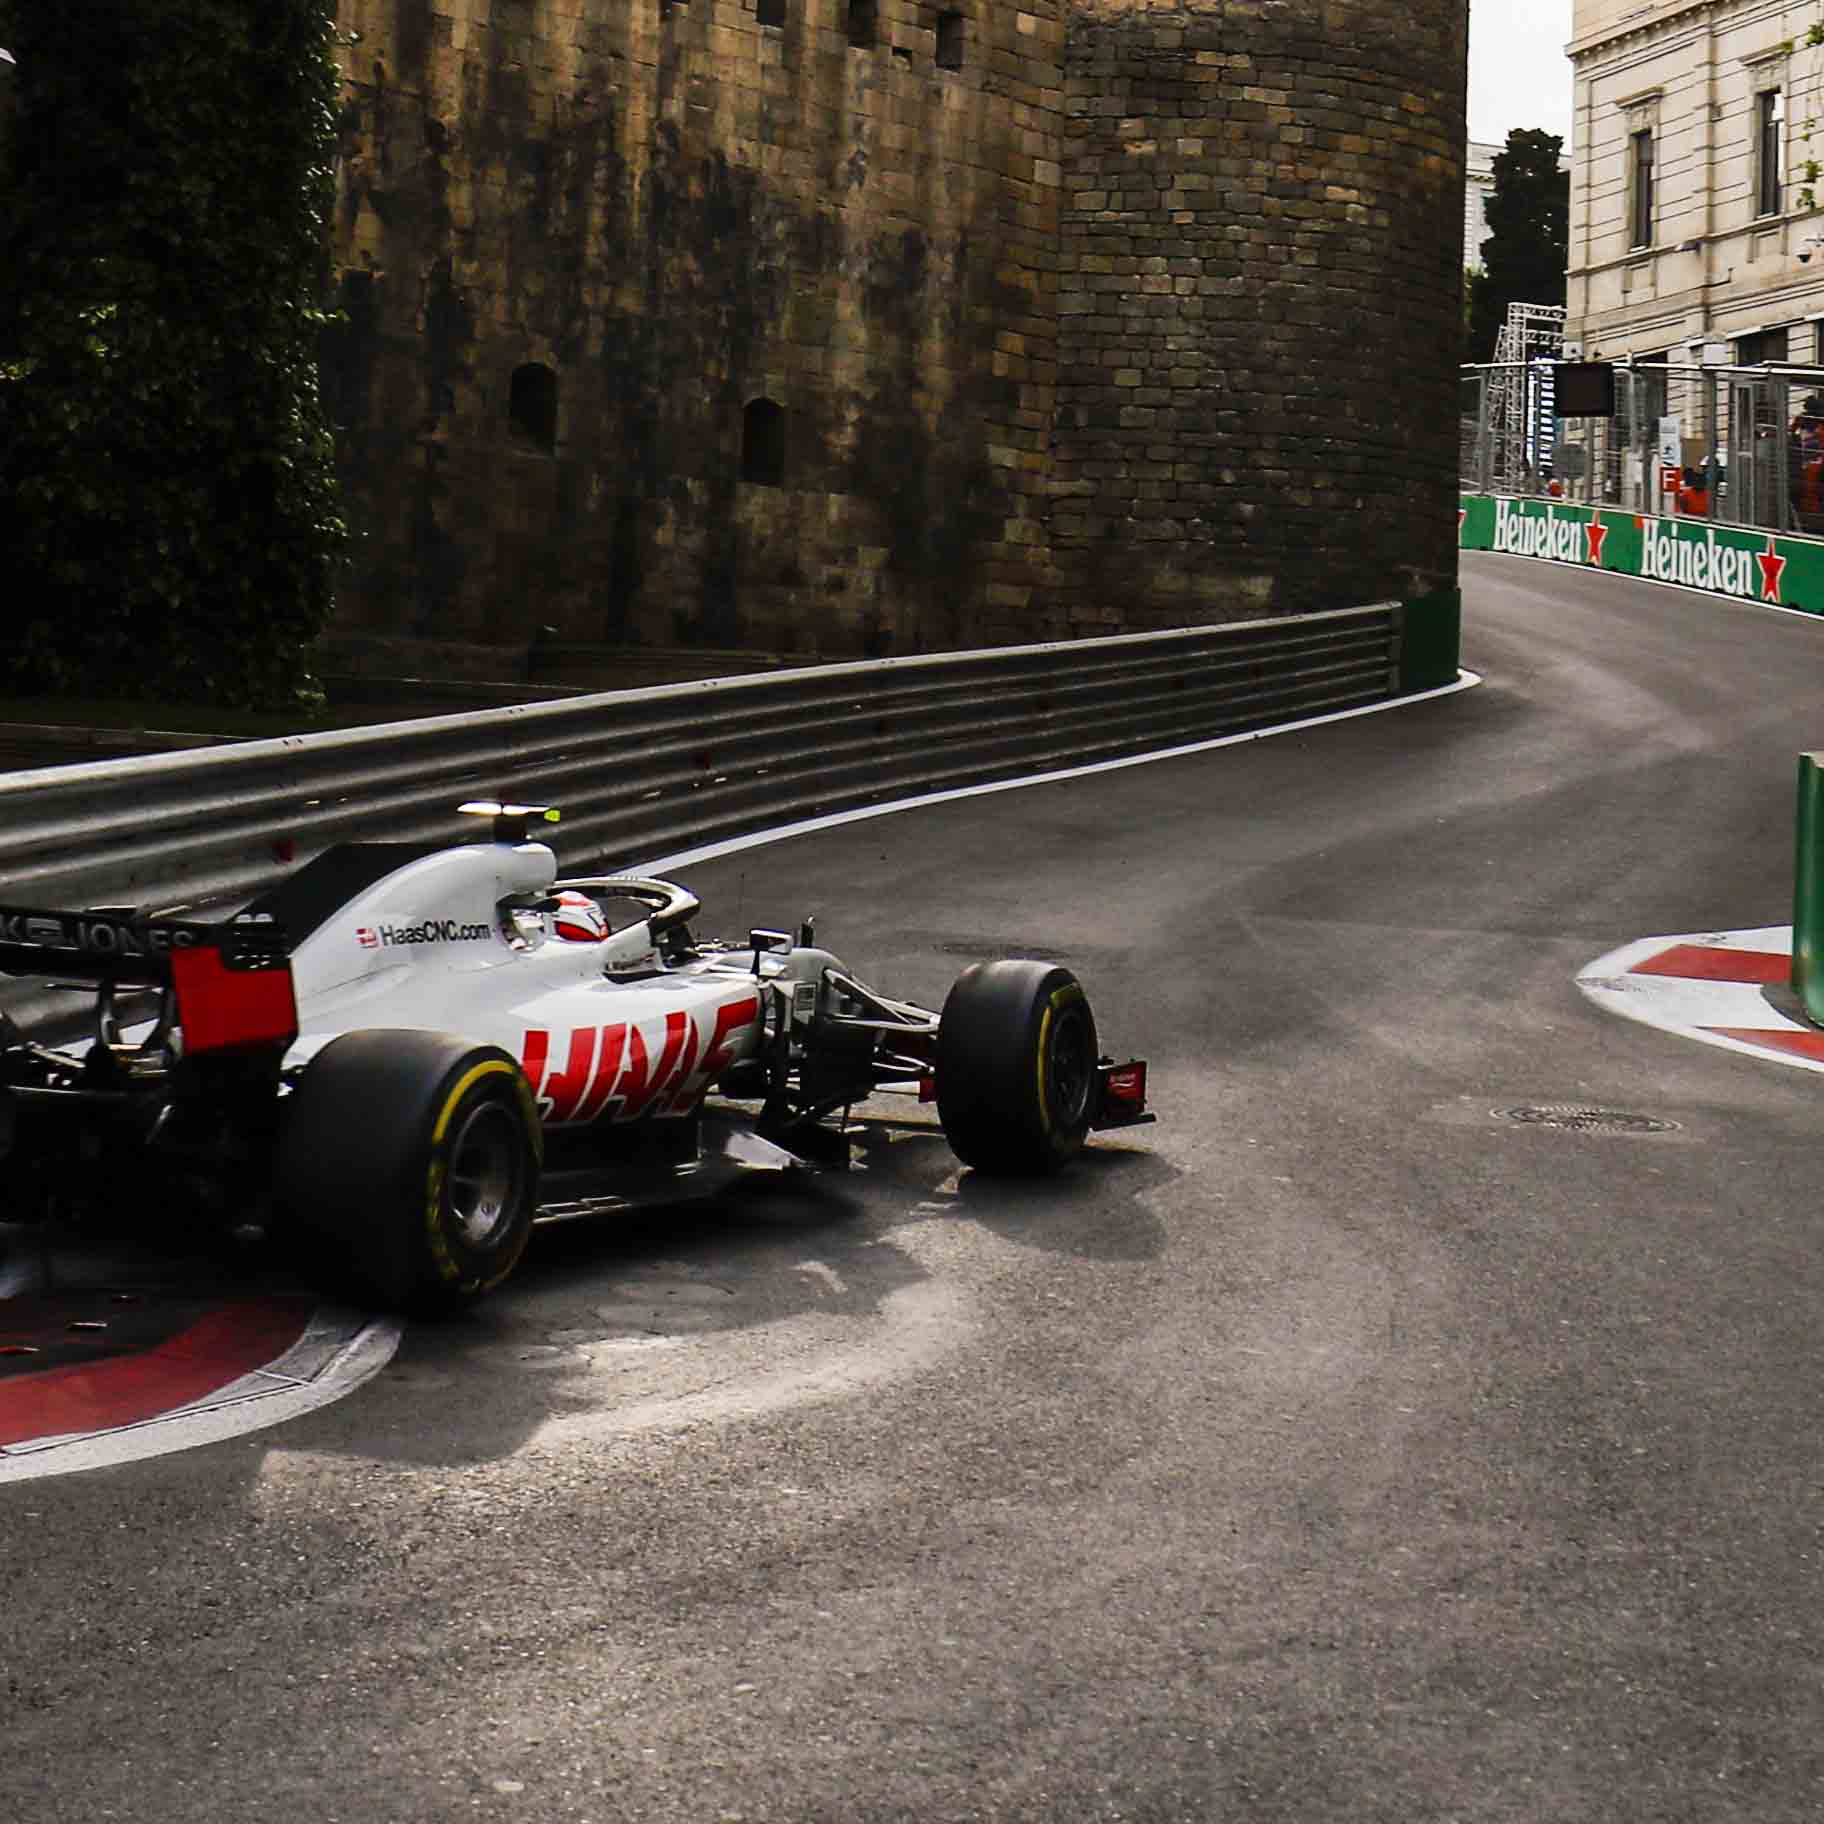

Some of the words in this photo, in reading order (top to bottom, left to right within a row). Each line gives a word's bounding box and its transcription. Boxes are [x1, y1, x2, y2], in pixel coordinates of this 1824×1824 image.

[1493, 499, 1581, 563] Heineken
[1641, 518, 1754, 596] Heineken
[378, 919, 492, 945] HaasCNC.com
[522, 996, 758, 1121] HAAS
